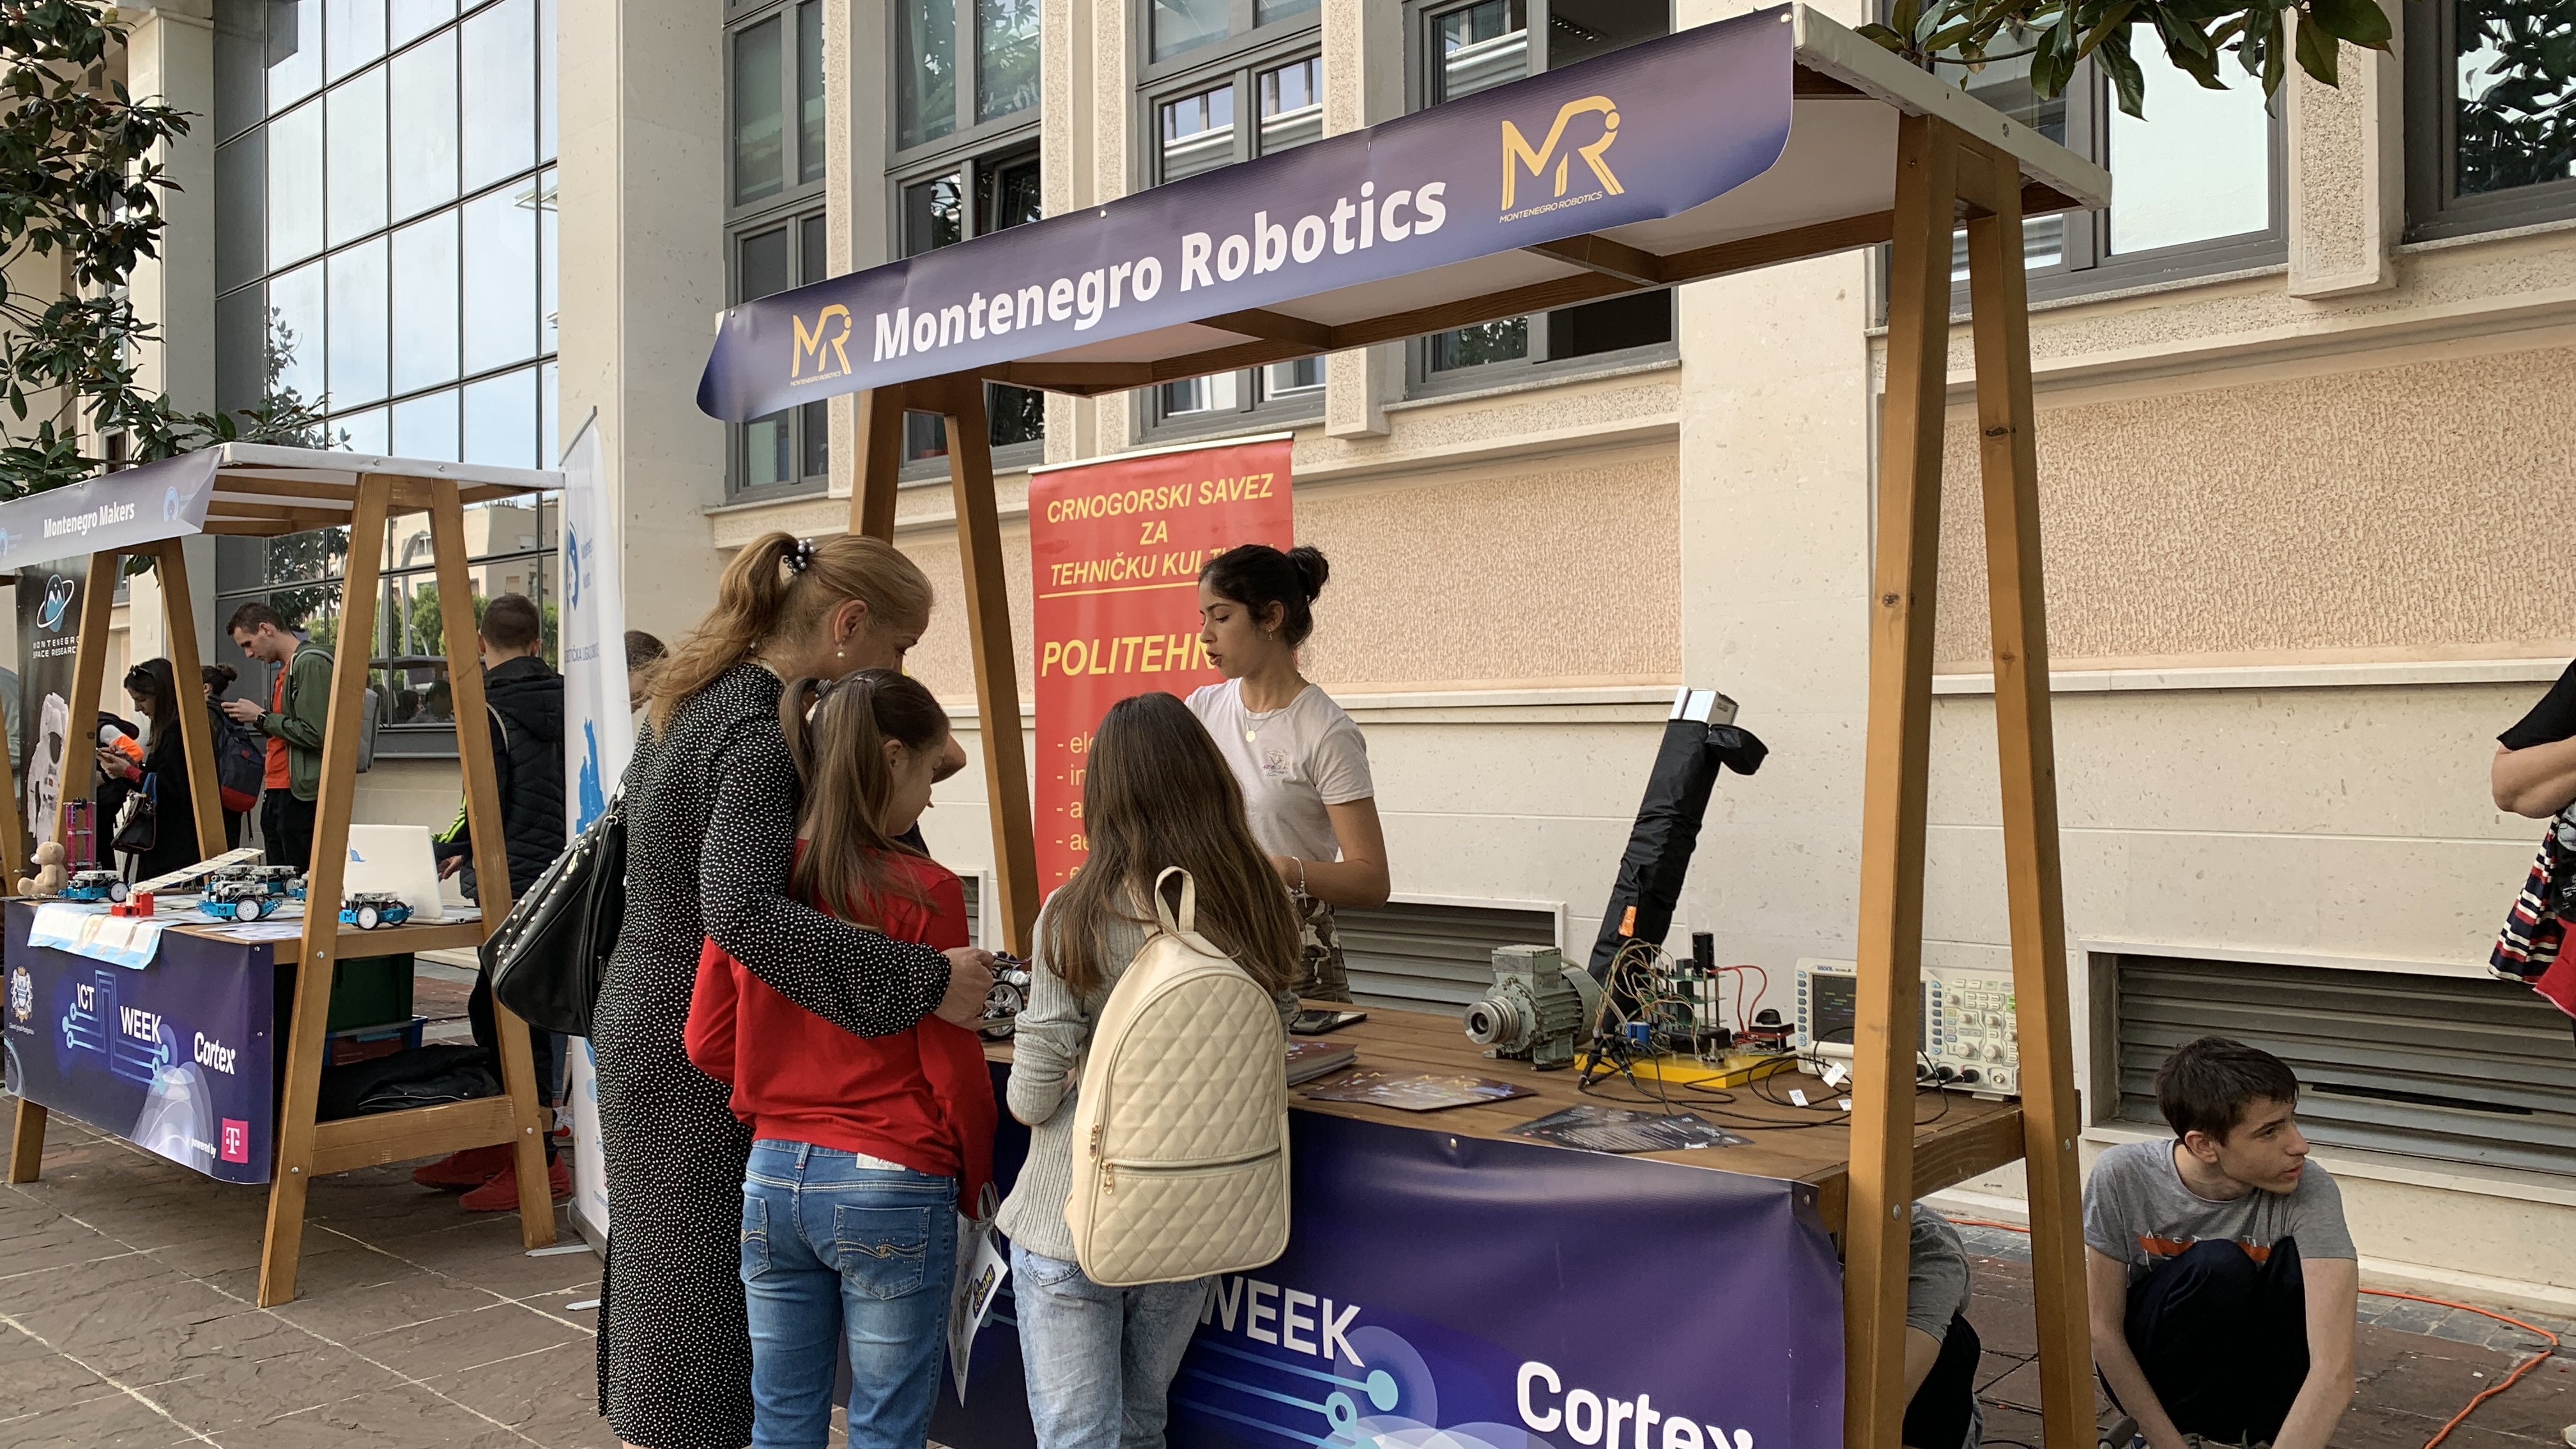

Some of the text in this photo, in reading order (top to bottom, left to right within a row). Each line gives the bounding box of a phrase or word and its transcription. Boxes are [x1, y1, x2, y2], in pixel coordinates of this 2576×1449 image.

[1499, 191, 1603, 224] MONTENEGRO ROBOTICS
[873, 181, 1446, 362] Montenegro Robotics
[1046, 473, 1274, 523] CRNOGORSKI SAVEZ
[43, 502, 135, 538] Montenegro Makers
[1140, 520, 1169, 545] ZA
[1050, 552, 1157, 586] TEHNIČKU
[51, 646, 77, 656] RESEARC
[77, 982, 95, 1011] ICT
[119, 1005, 162, 1044] WEEK
[194, 1031, 236, 1075] Cortex
